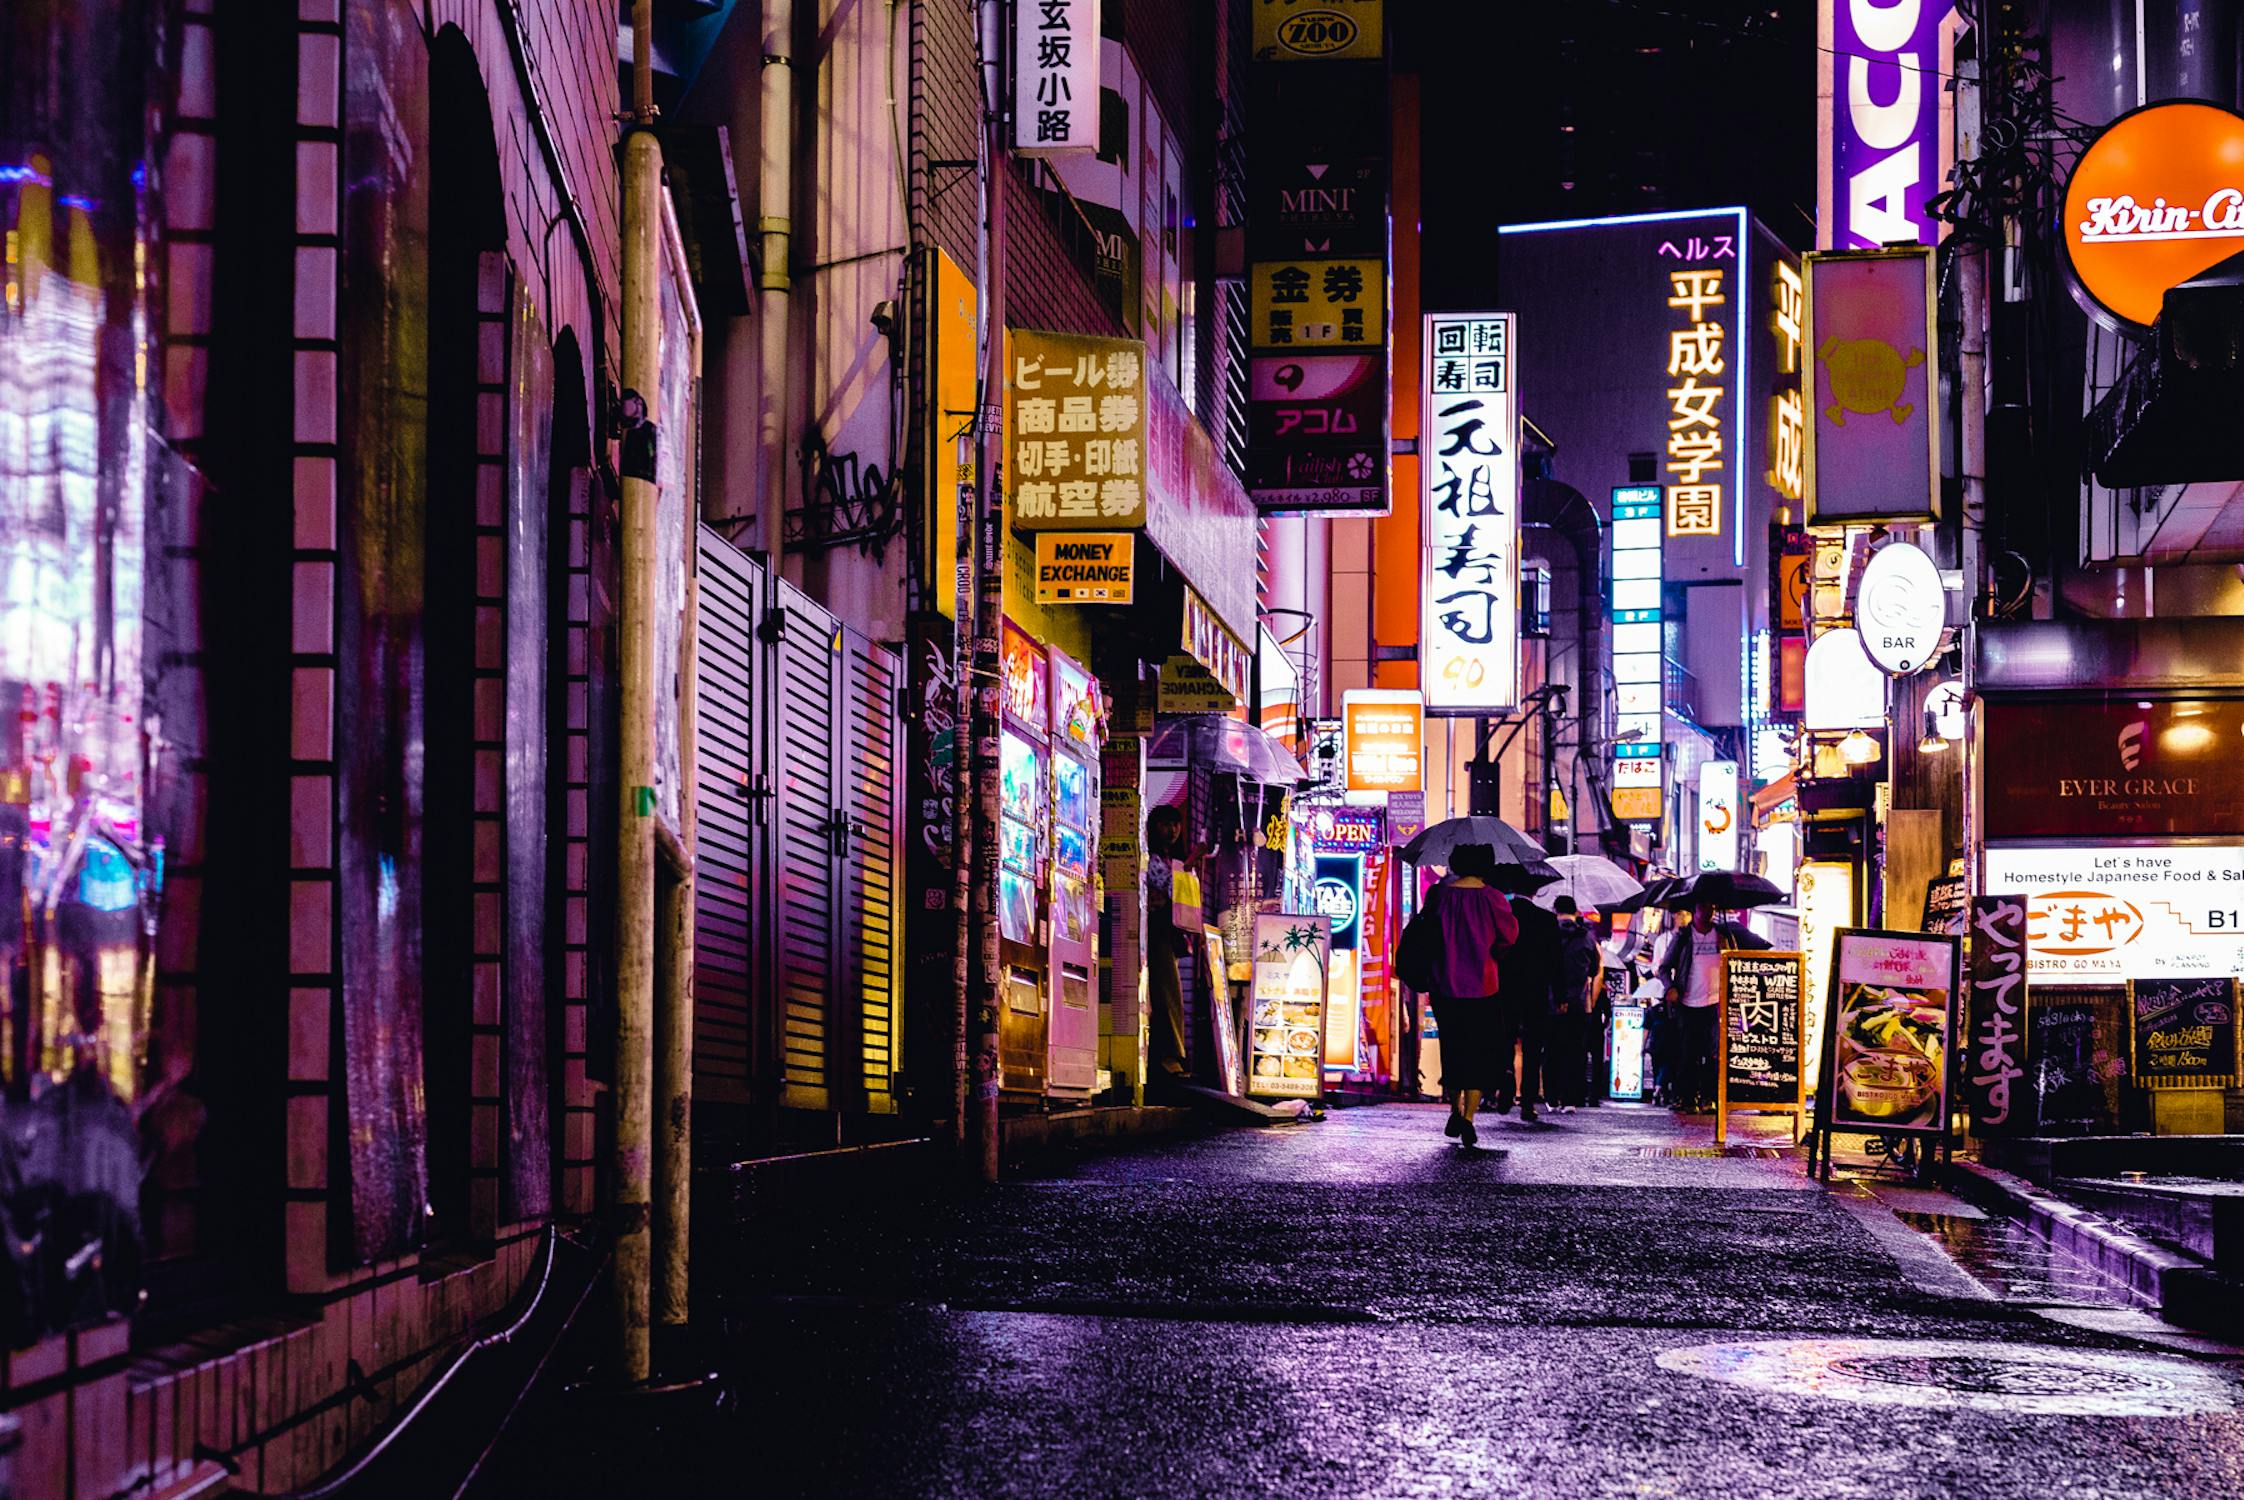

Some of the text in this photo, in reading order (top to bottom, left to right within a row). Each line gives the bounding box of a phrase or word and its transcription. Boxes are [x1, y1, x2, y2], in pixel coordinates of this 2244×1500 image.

[1288, 22, 1350, 43] ZOO
[1037, 0, 1071, 142] 玄坂小路
[1280, 187, 1356, 213] MINT
[1658, 236, 1736, 261] ヘルス
[1270, 266, 1363, 303] 金券
[1437, 325, 1501, 353] 回転
[1016, 351, 1140, 390] ビール券
[1437, 360, 1501, 392] 寿司
[1017, 395, 1139, 435] 商品券
[1666, 268, 1725, 537] 平成女学園
[1275, 408, 1358, 435] アコム
[1017, 439, 1139, 477] 切手・印紙
[1016, 479, 1140, 518] 航空券
[1432, 400, 1504, 643] 元祖寿司
[1055, 543, 1114, 561] MONEY
[1040, 565, 1130, 582] EXCHANGE
[1883, 637, 1915, 649] BAR
[2059, 778, 2199, 796] EVER GRACE
[2098, 801, 2161, 812] Beauty Salon
[1321, 824, 1371, 842] OPEN
[2136, 857, 2171, 868] have
[2004, 872, 2082, 884] Homestyle
[2088, 871, 2158, 884] Japanese
[2164, 870, 2201, 881] Food
[2207, 870, 2216, 881] &
[1315, 886, 1347, 901] TAX
[2026, 903, 2131, 941] ごまや
[2208, 909, 2241, 928] B1
[2026, 959, 2067, 969] BISTRO
[2074, 960, 2088, 968] GO
[1763, 975, 1798, 987] WINE
[1740, 990, 1779, 1034] 肉
[1971, 899, 2024, 1125] やってます
[1742, 1033, 1779, 1044] ビストロ
[1855, 1055, 1934, 1083] ごまや
